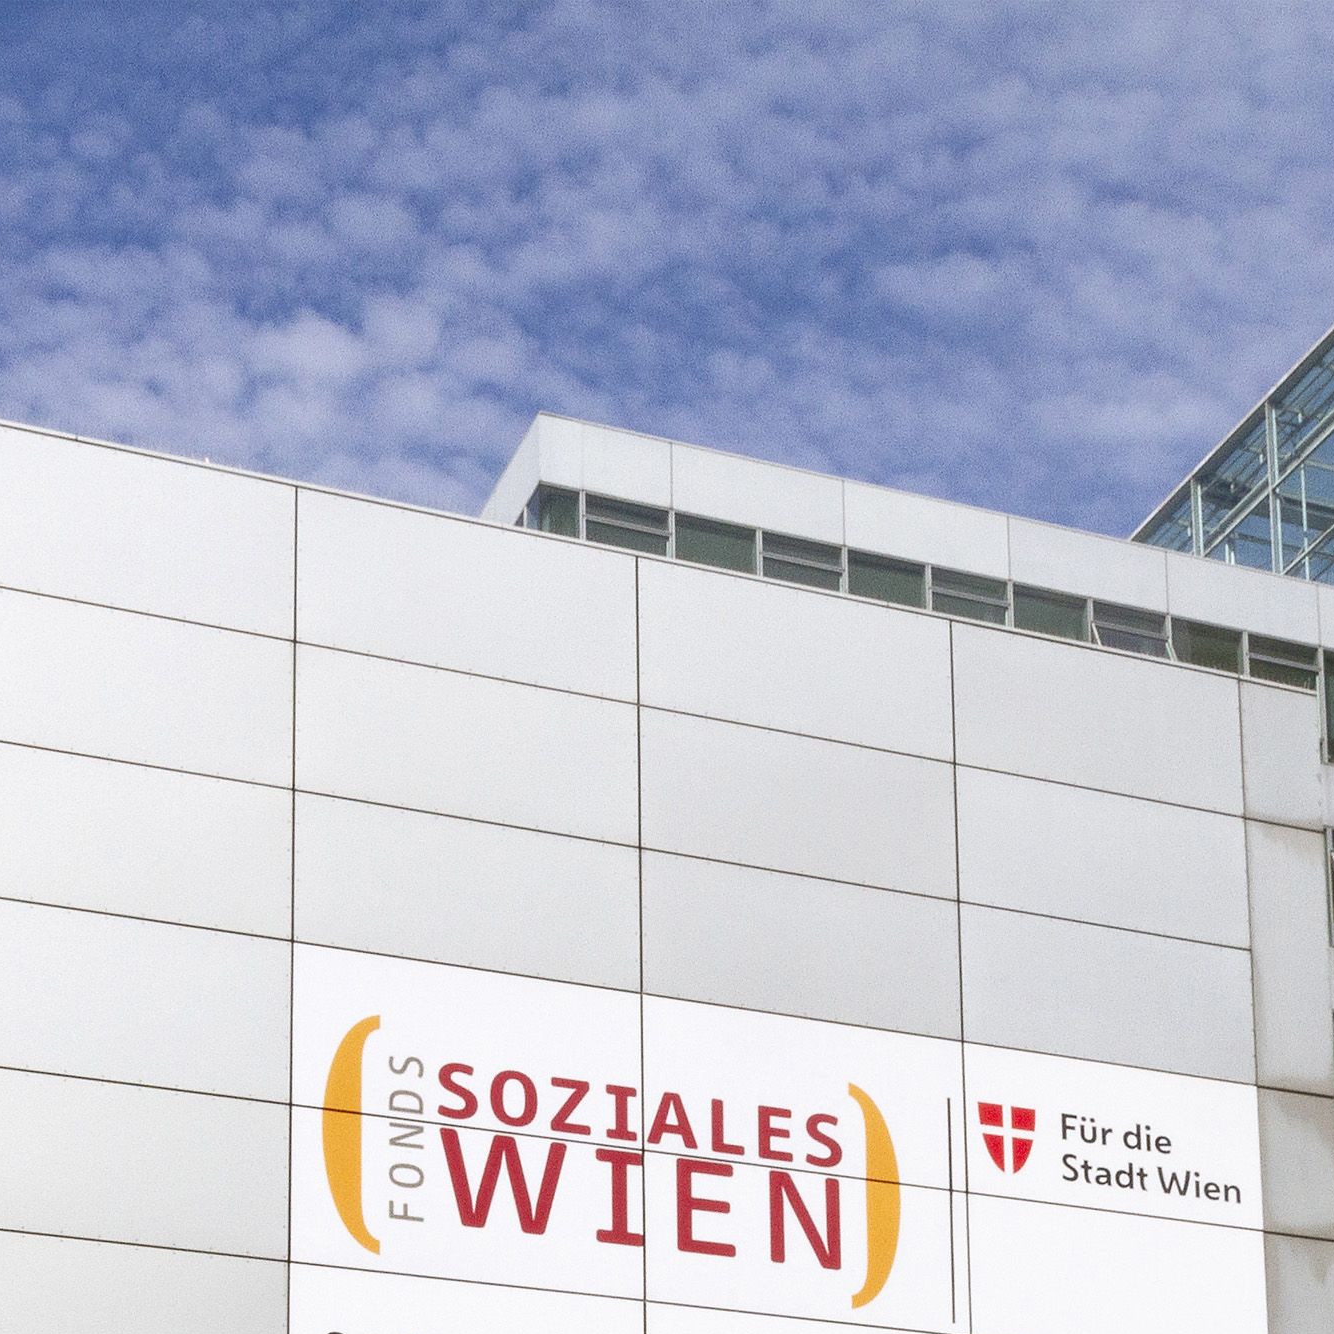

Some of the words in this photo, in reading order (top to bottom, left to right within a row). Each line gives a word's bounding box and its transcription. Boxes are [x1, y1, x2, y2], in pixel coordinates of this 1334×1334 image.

[388, 1055, 425, 1223] FONDS
[438, 1063, 842, 1168] SOZIALES
[1061, 1113, 1113, 1146] Für
[1123, 1123, 1173, 1155] die
[440, 1127, 841, 1270] WIEN
[1062, 1153, 1148, 1191] Stadt
[1157, 1166, 1242, 1204] Wien
